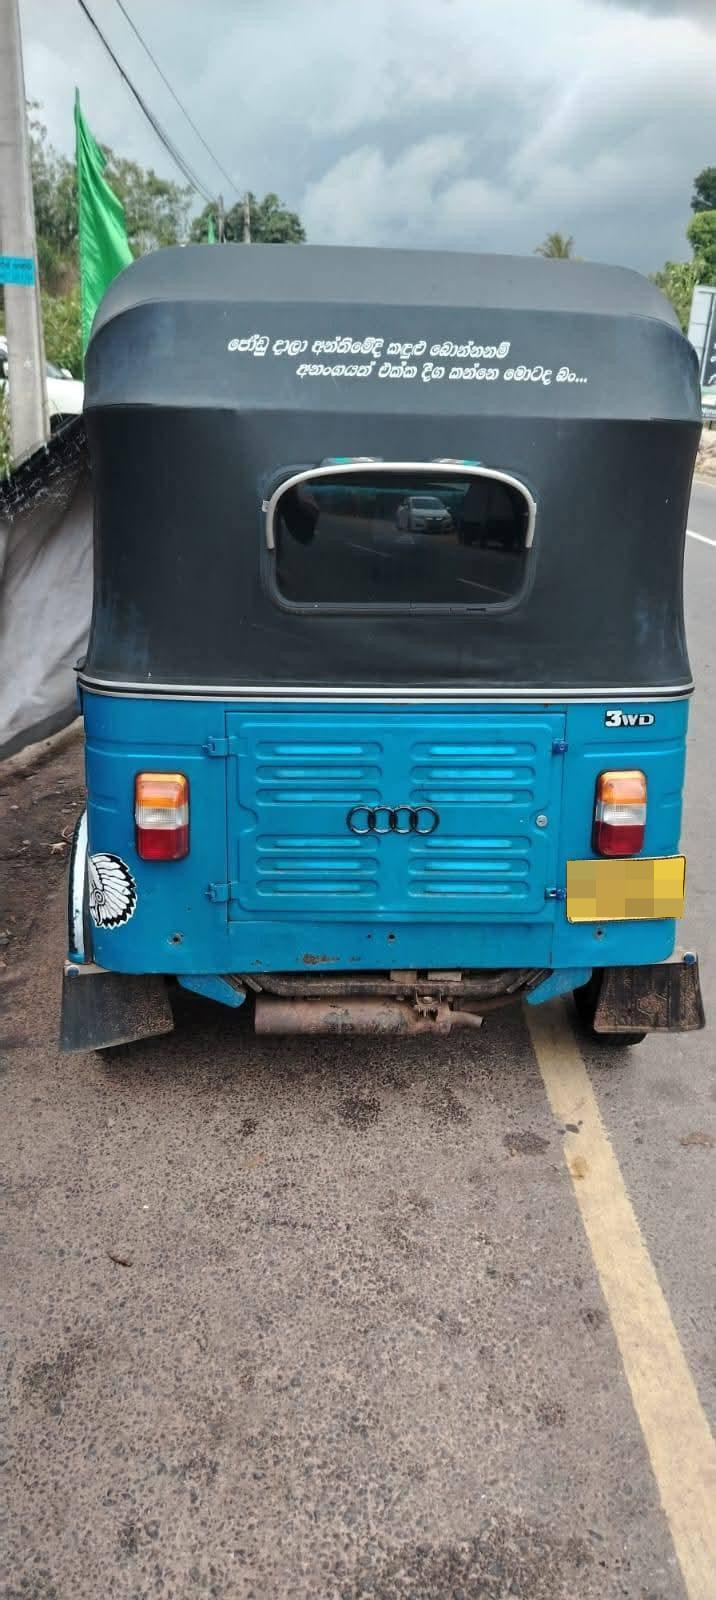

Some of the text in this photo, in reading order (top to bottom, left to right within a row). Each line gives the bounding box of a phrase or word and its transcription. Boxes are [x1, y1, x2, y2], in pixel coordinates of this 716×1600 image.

[272, 341, 309, 356] දාලා
[430, 341, 511, 359] බොන්නනම්
[379, 361, 418, 378] එක්ක
[504, 367, 553, 386] මොටද
[557, 367, 588, 384] බං...
[604, 710, 655, 728] 3WD
